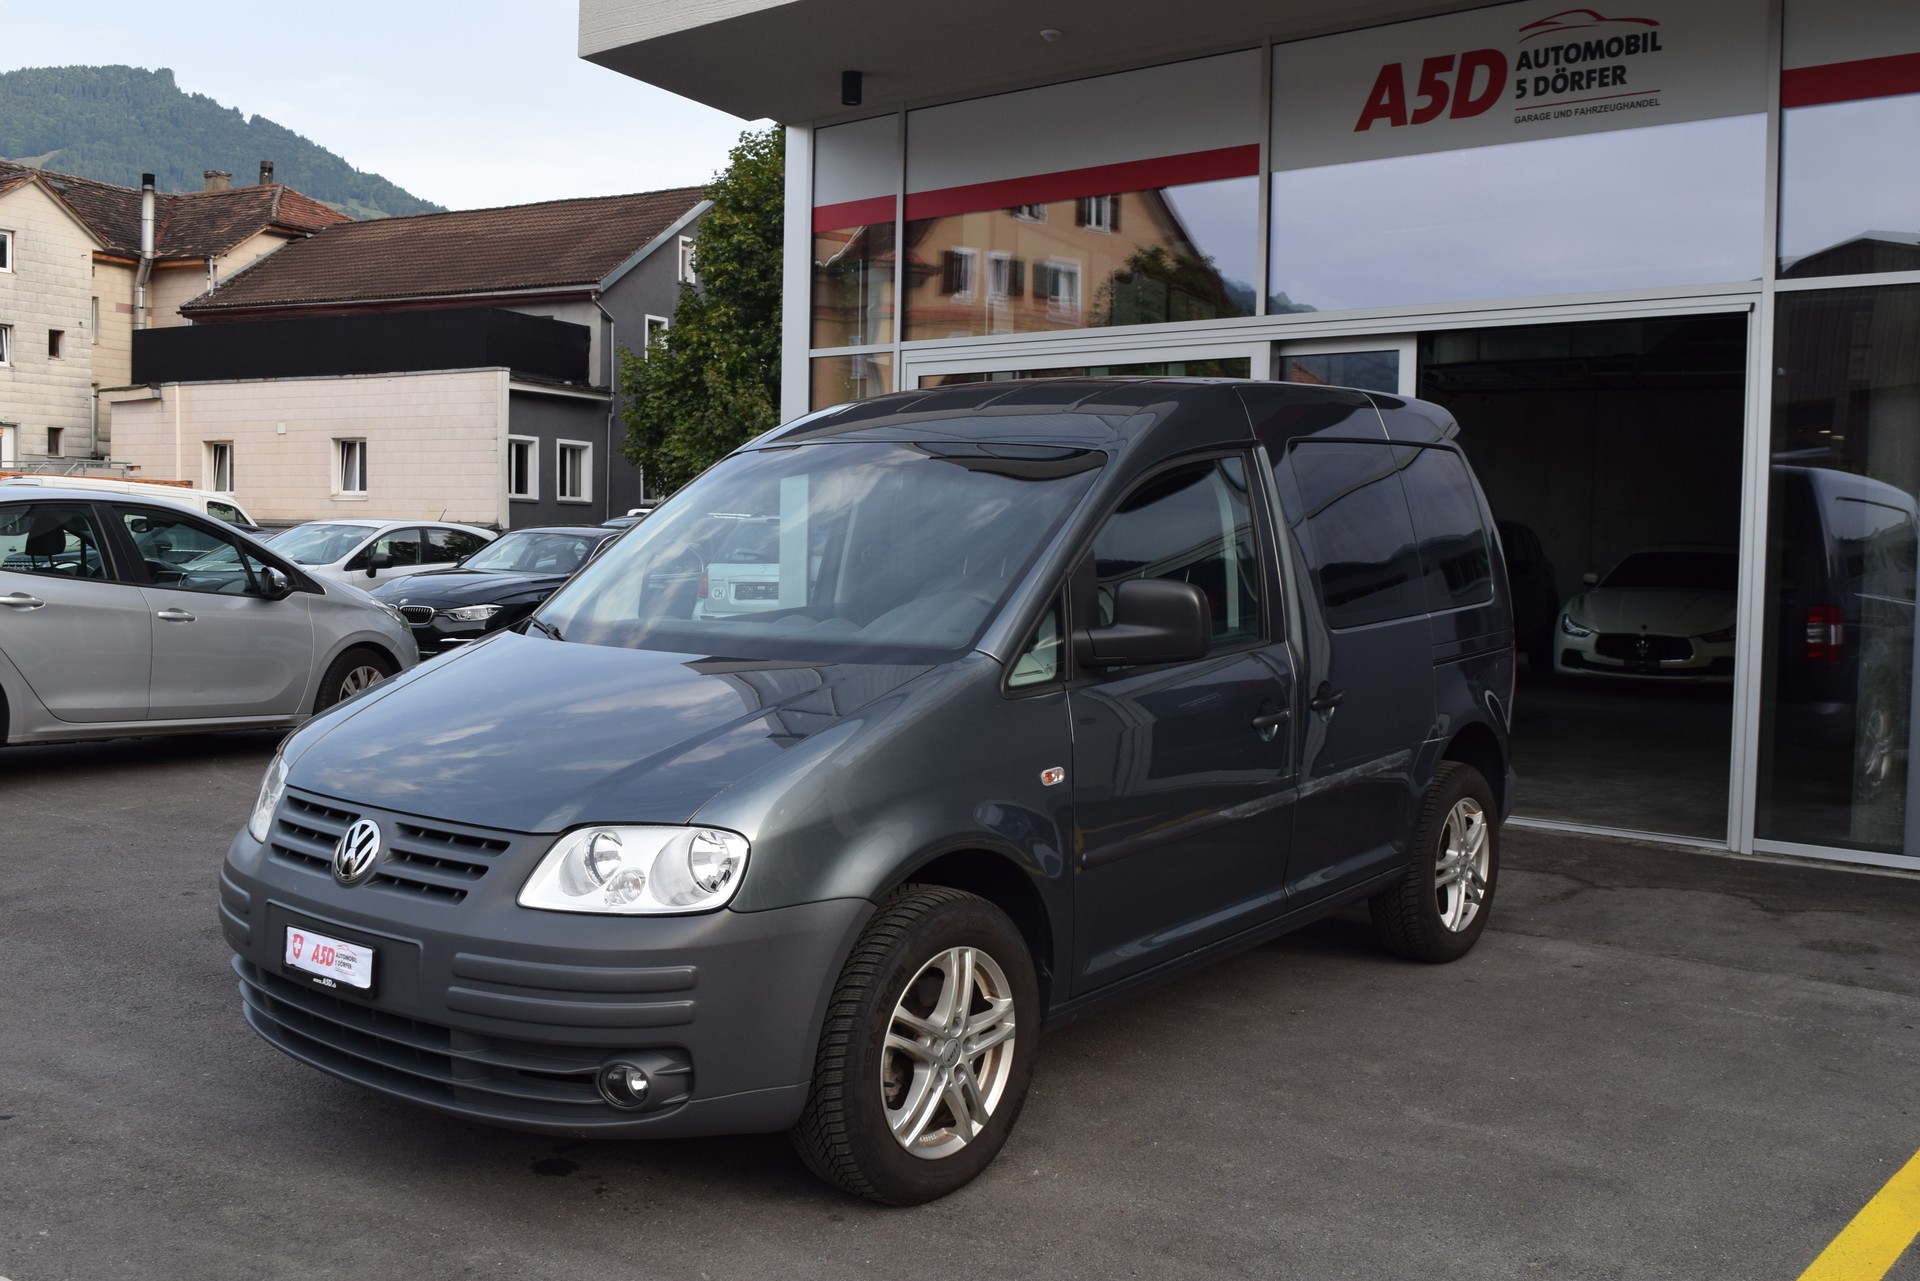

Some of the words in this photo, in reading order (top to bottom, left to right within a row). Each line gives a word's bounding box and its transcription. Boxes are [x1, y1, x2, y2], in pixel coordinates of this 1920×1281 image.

[1515, 31, 1662, 71] AUTOMOBIL
[1353, 48, 1508, 132] A5D
[1515, 79, 1527, 100] 5
[1534, 64, 1627, 97] DÖRFER
[1514, 111, 1552, 124] GARAGE
[1553, 107, 1573, 120] UND
[1574, 98, 1661, 117] FAHRZEUGHANDEL
[311, 944, 335, 966] A5D
